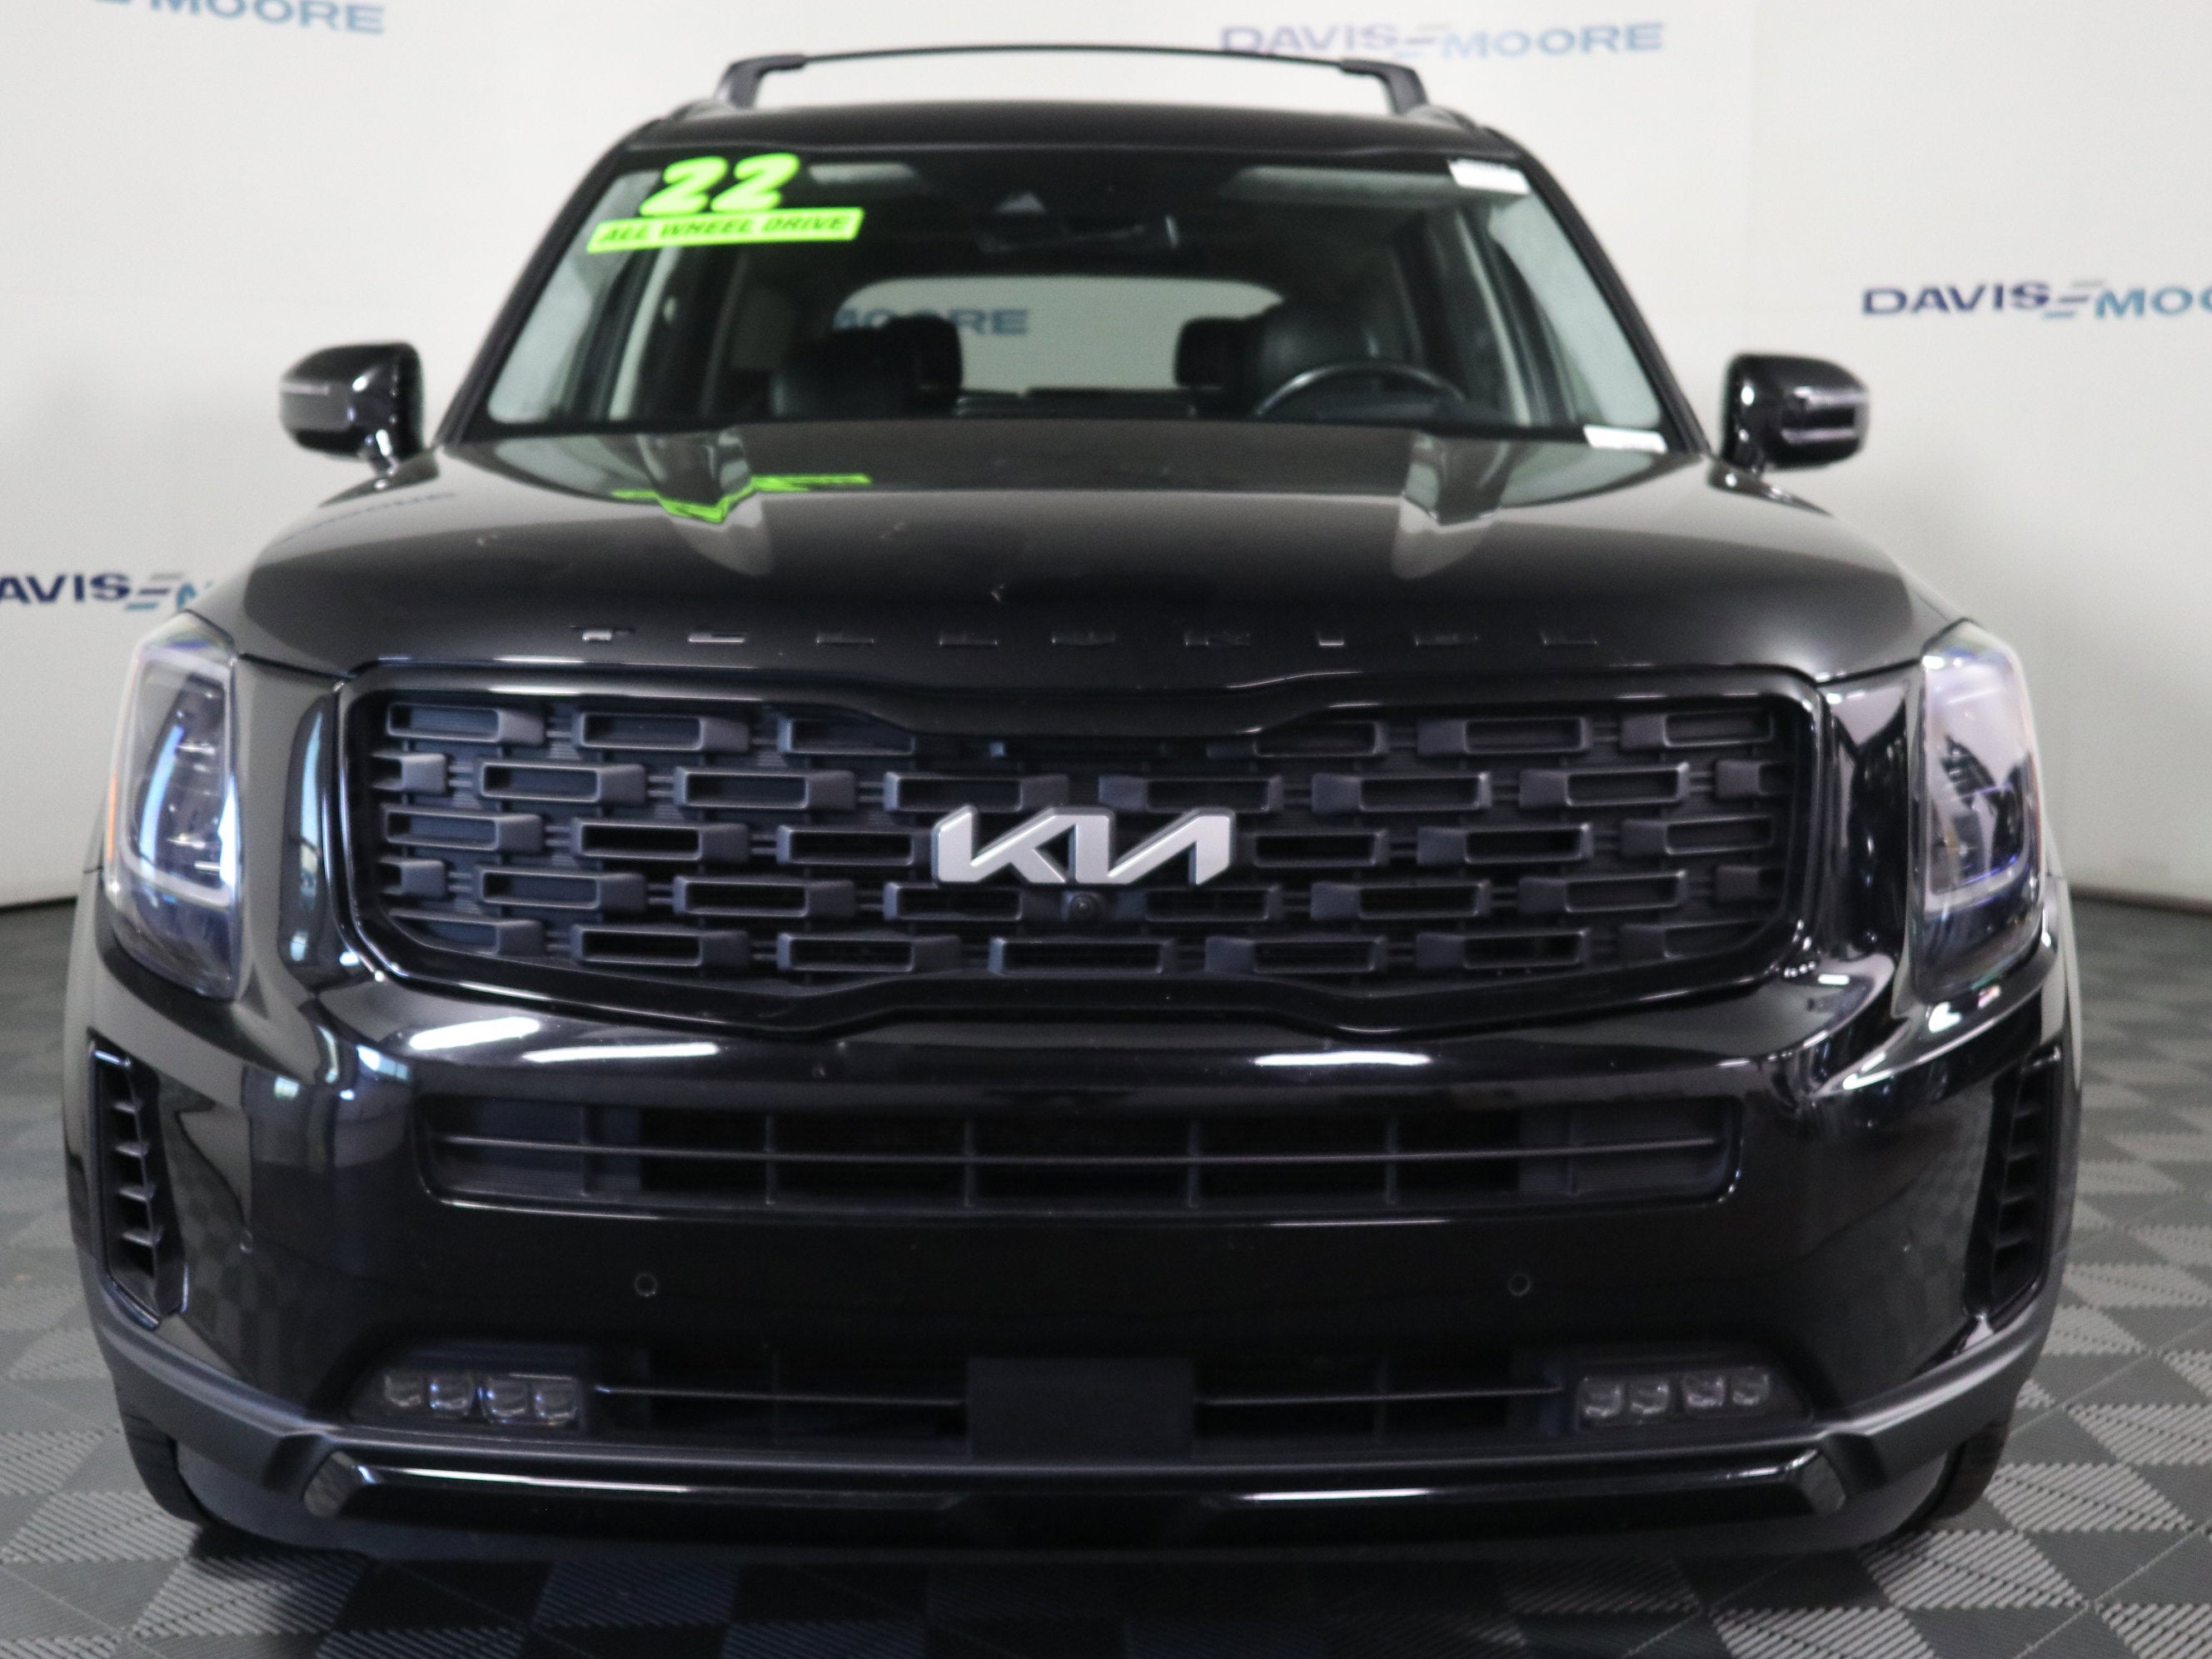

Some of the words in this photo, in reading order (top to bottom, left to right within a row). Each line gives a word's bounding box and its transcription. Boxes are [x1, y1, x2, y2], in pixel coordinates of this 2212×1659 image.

[1219, 22, 1397, 52] DAVIS
[1442, 22, 1663, 58] MOORE
[640, 152, 800, 217] 22
[599, 224, 650, 242] ALL
[660, 217, 752, 238] WHEEL
[762, 214, 845, 233] DRIVE
[1863, 281, 2049, 316] DAVIS
[932, 805, 1235, 885] KIA
